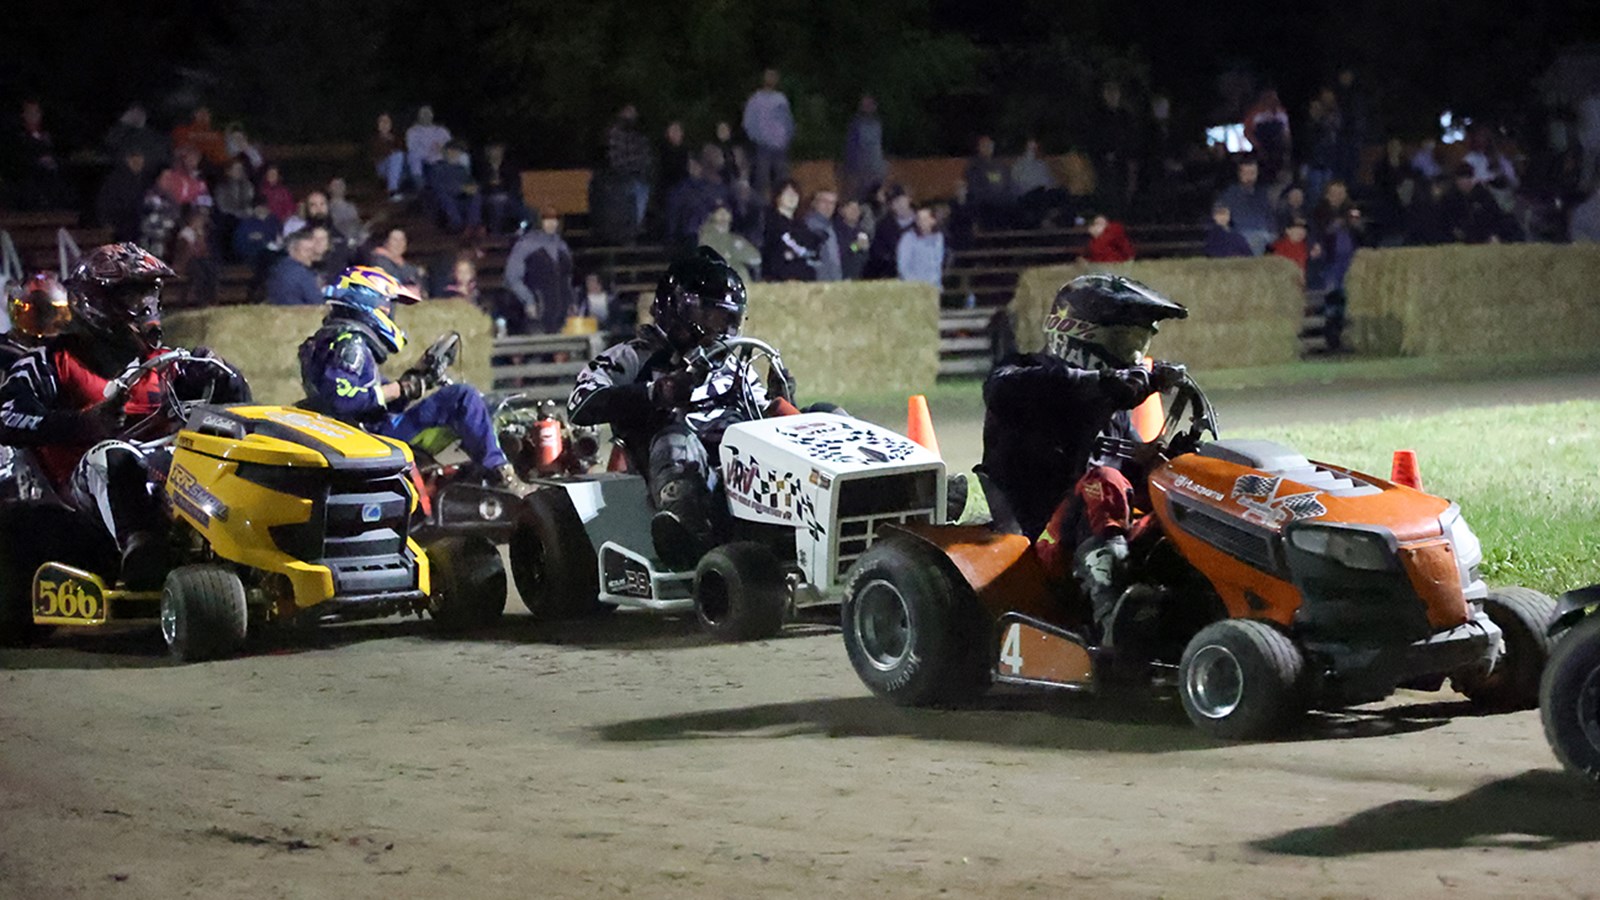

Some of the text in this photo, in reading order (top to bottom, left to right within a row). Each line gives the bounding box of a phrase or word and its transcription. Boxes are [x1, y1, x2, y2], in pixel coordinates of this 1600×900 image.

[1183, 479, 1225, 502] Husqvarna
[39, 580, 98, 618] 566
[1000, 623, 1024, 675] 4
